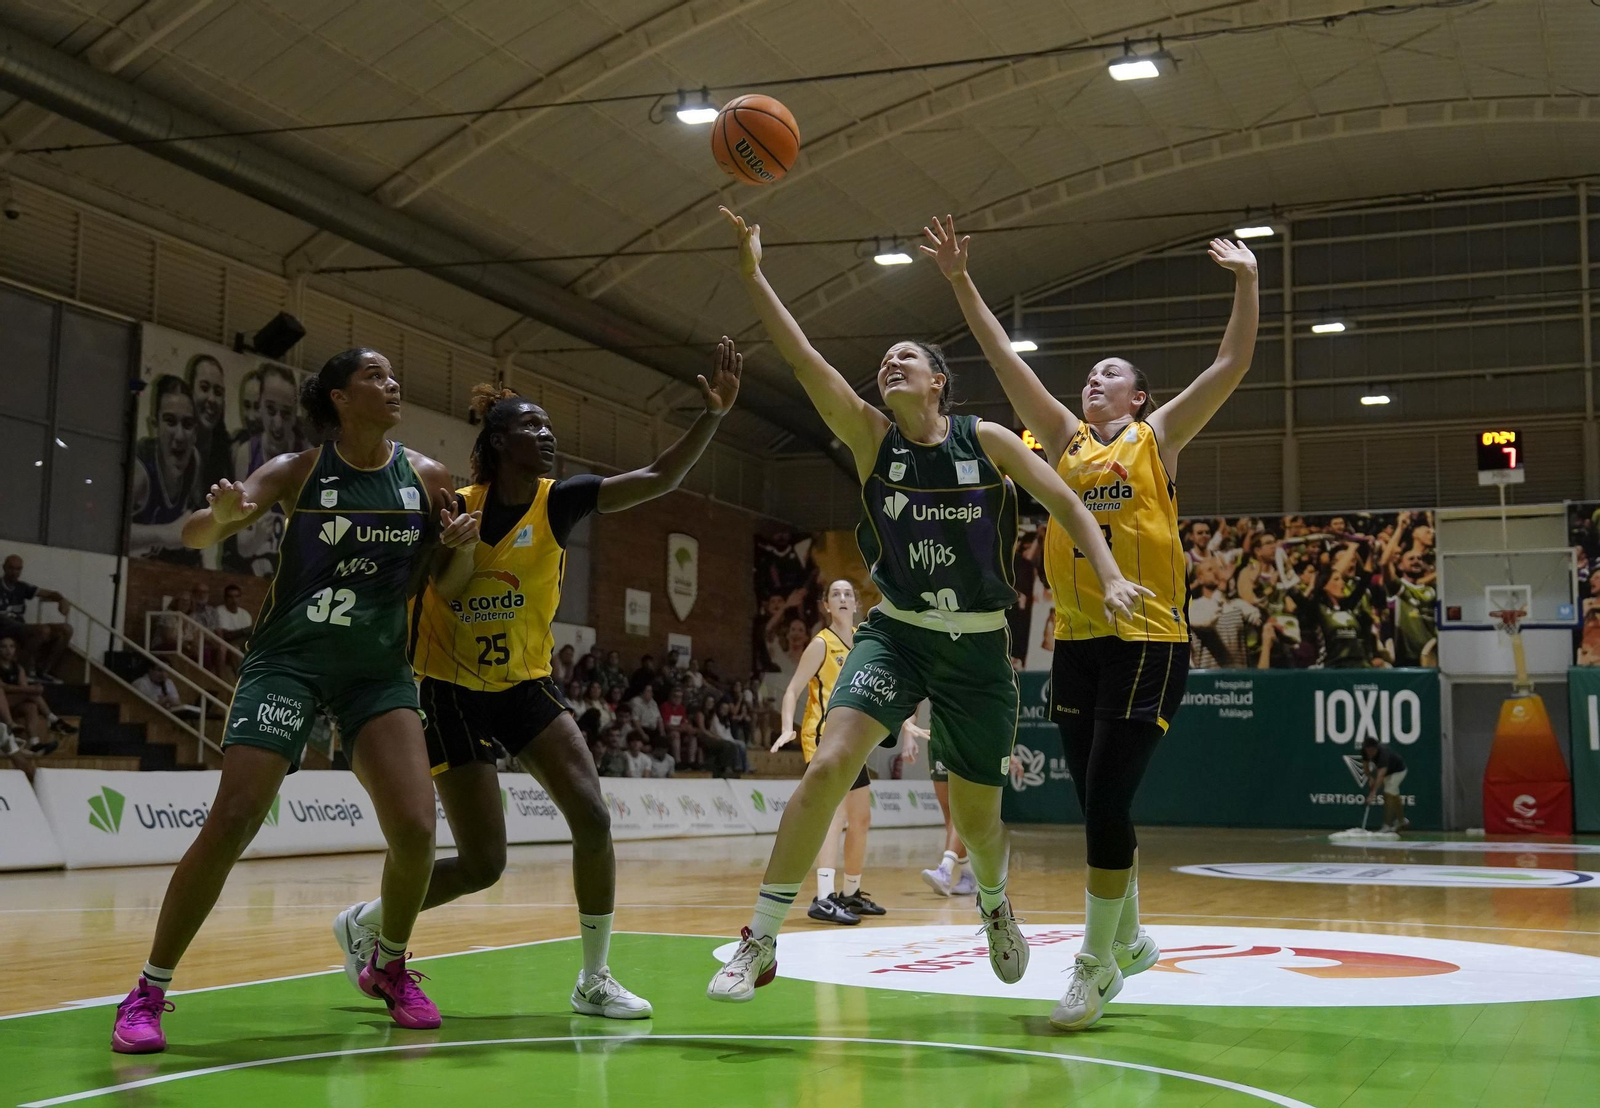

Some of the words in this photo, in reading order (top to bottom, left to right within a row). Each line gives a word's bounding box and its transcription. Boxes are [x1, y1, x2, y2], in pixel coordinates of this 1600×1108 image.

[735, 137, 776, 181] Wilson
[1502, 447, 1517, 469] 7
[913, 503, 982, 523] Unicaja
[1084, 501, 1122, 511] aterna
[356, 525, 420, 546] Unicaja
[908, 538, 956, 576] Mijas
[306, 587, 357, 626] 32
[468, 590, 525, 613] corda
[474, 610, 514, 622] Paterna
[475, 632, 510, 666] 25
[864, 663, 897, 686] CLINICAS
[1214, 680, 1253, 690] Hospital
[266, 692, 303, 710] CLINICAS
[849, 686, 884, 707] DENTAL
[258, 724, 292, 741] DENTAL
[1309, 793, 1366, 805] VERTIGO
[288, 798, 363, 827] Unicaja
[515, 803, 558, 820] Unicaja
